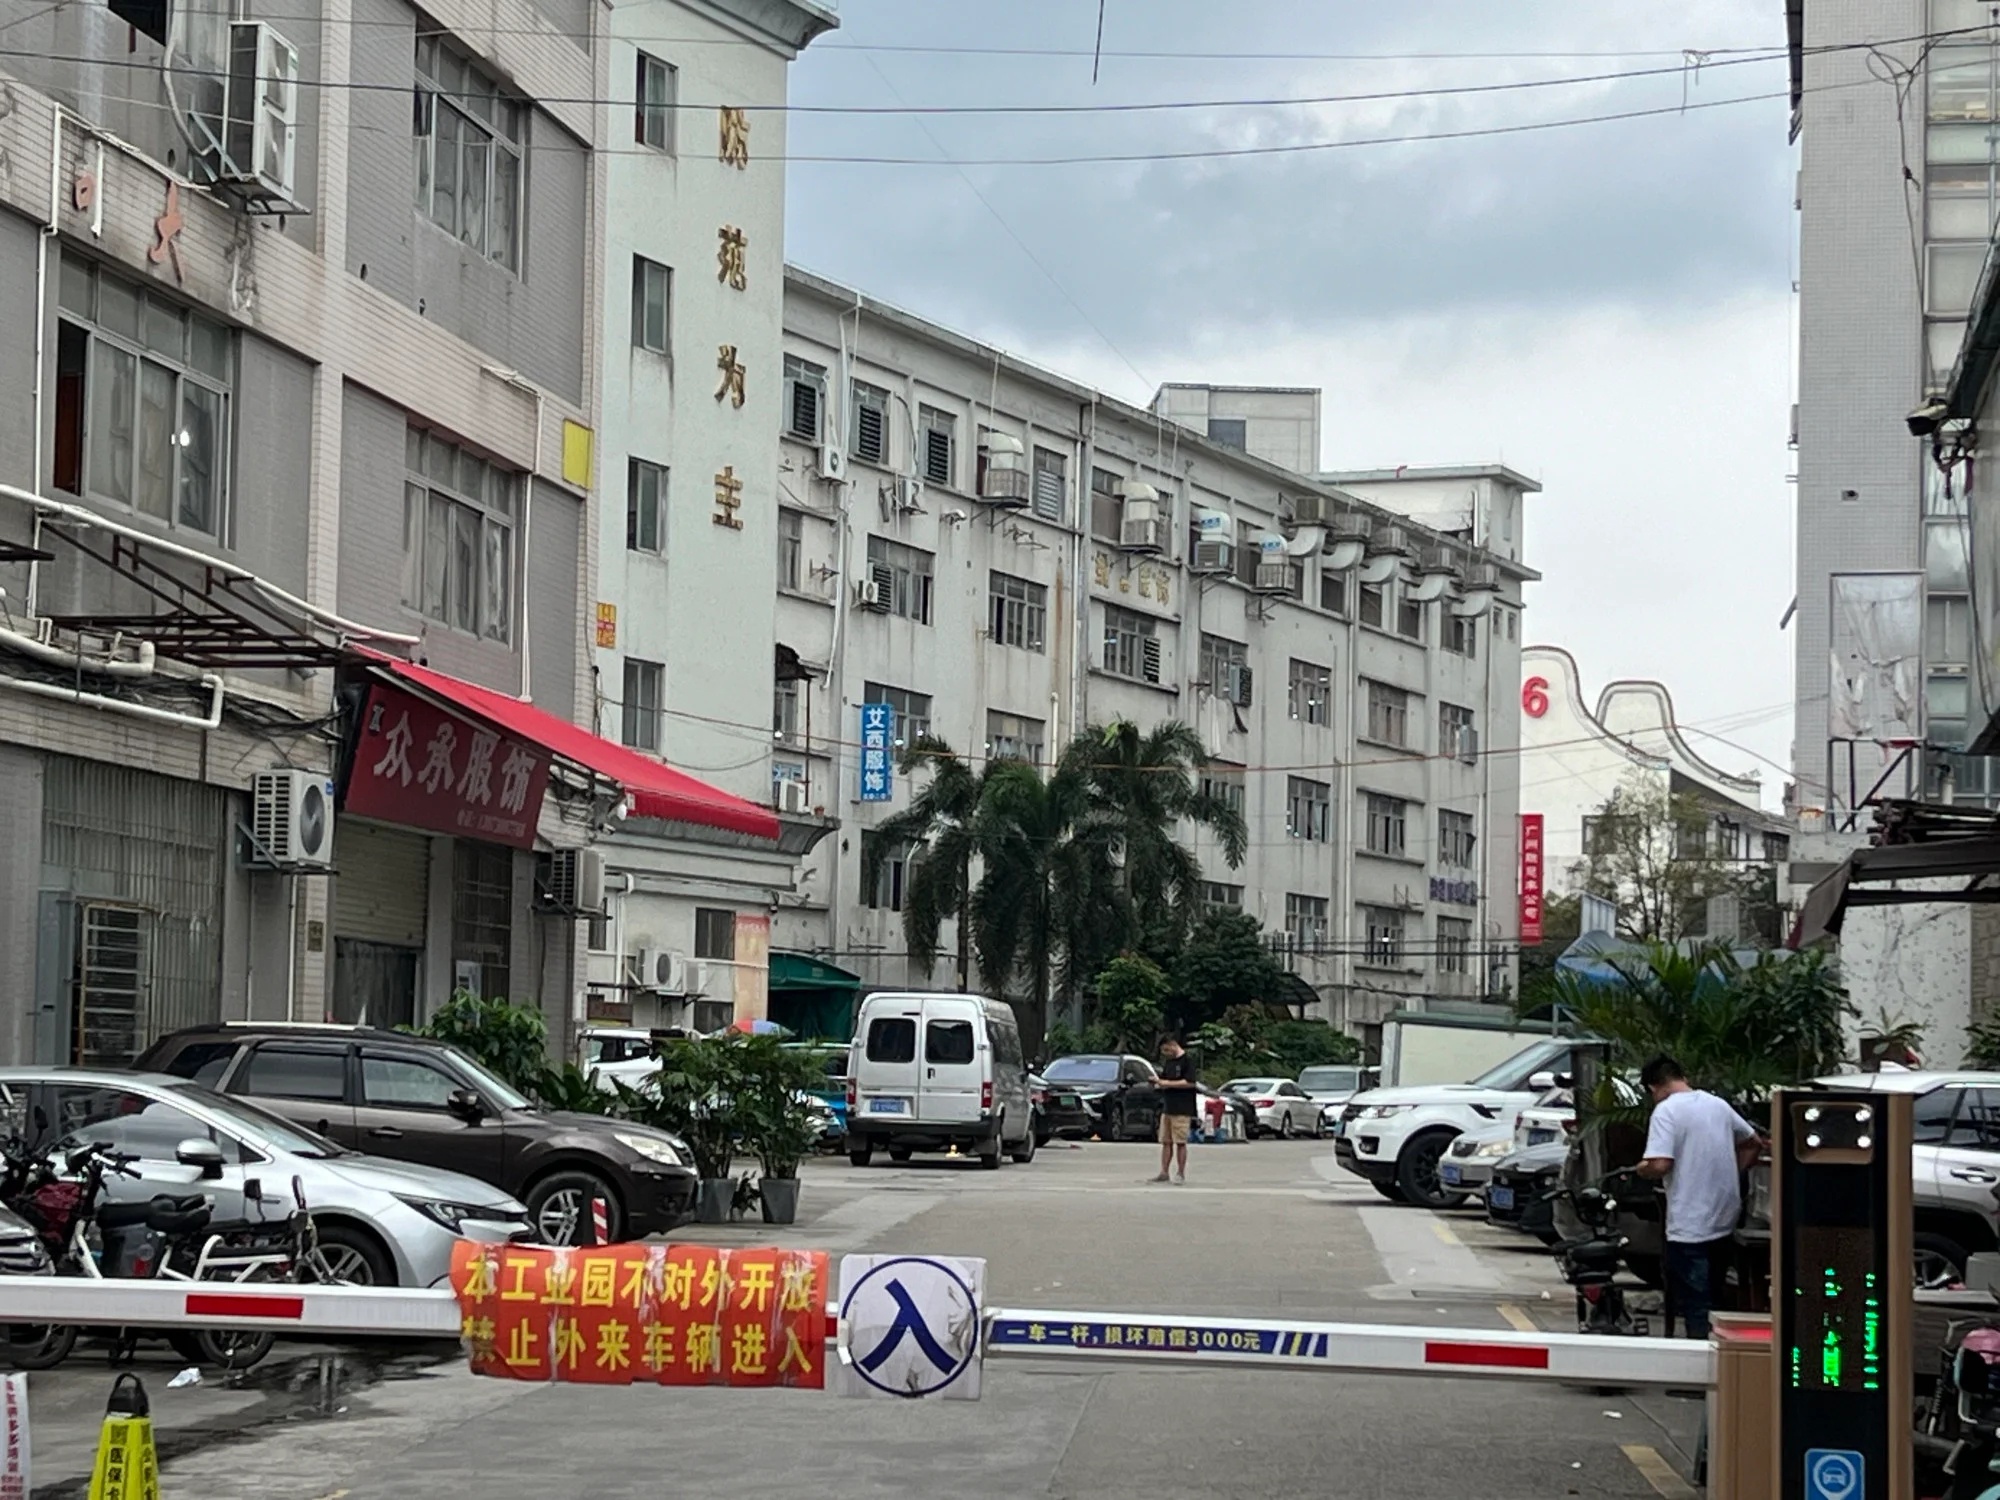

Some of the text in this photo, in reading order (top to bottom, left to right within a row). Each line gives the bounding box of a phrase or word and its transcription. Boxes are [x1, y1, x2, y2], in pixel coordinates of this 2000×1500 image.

[1522, 676, 1549, 718] 6
[372, 709, 537, 815] 众承服饰
[463, 1252, 816, 1313] 本工业园不对外开放
[463, 1315, 813, 1375] 禁止外来车辆进入
[858, 1278, 959, 1376] 入
